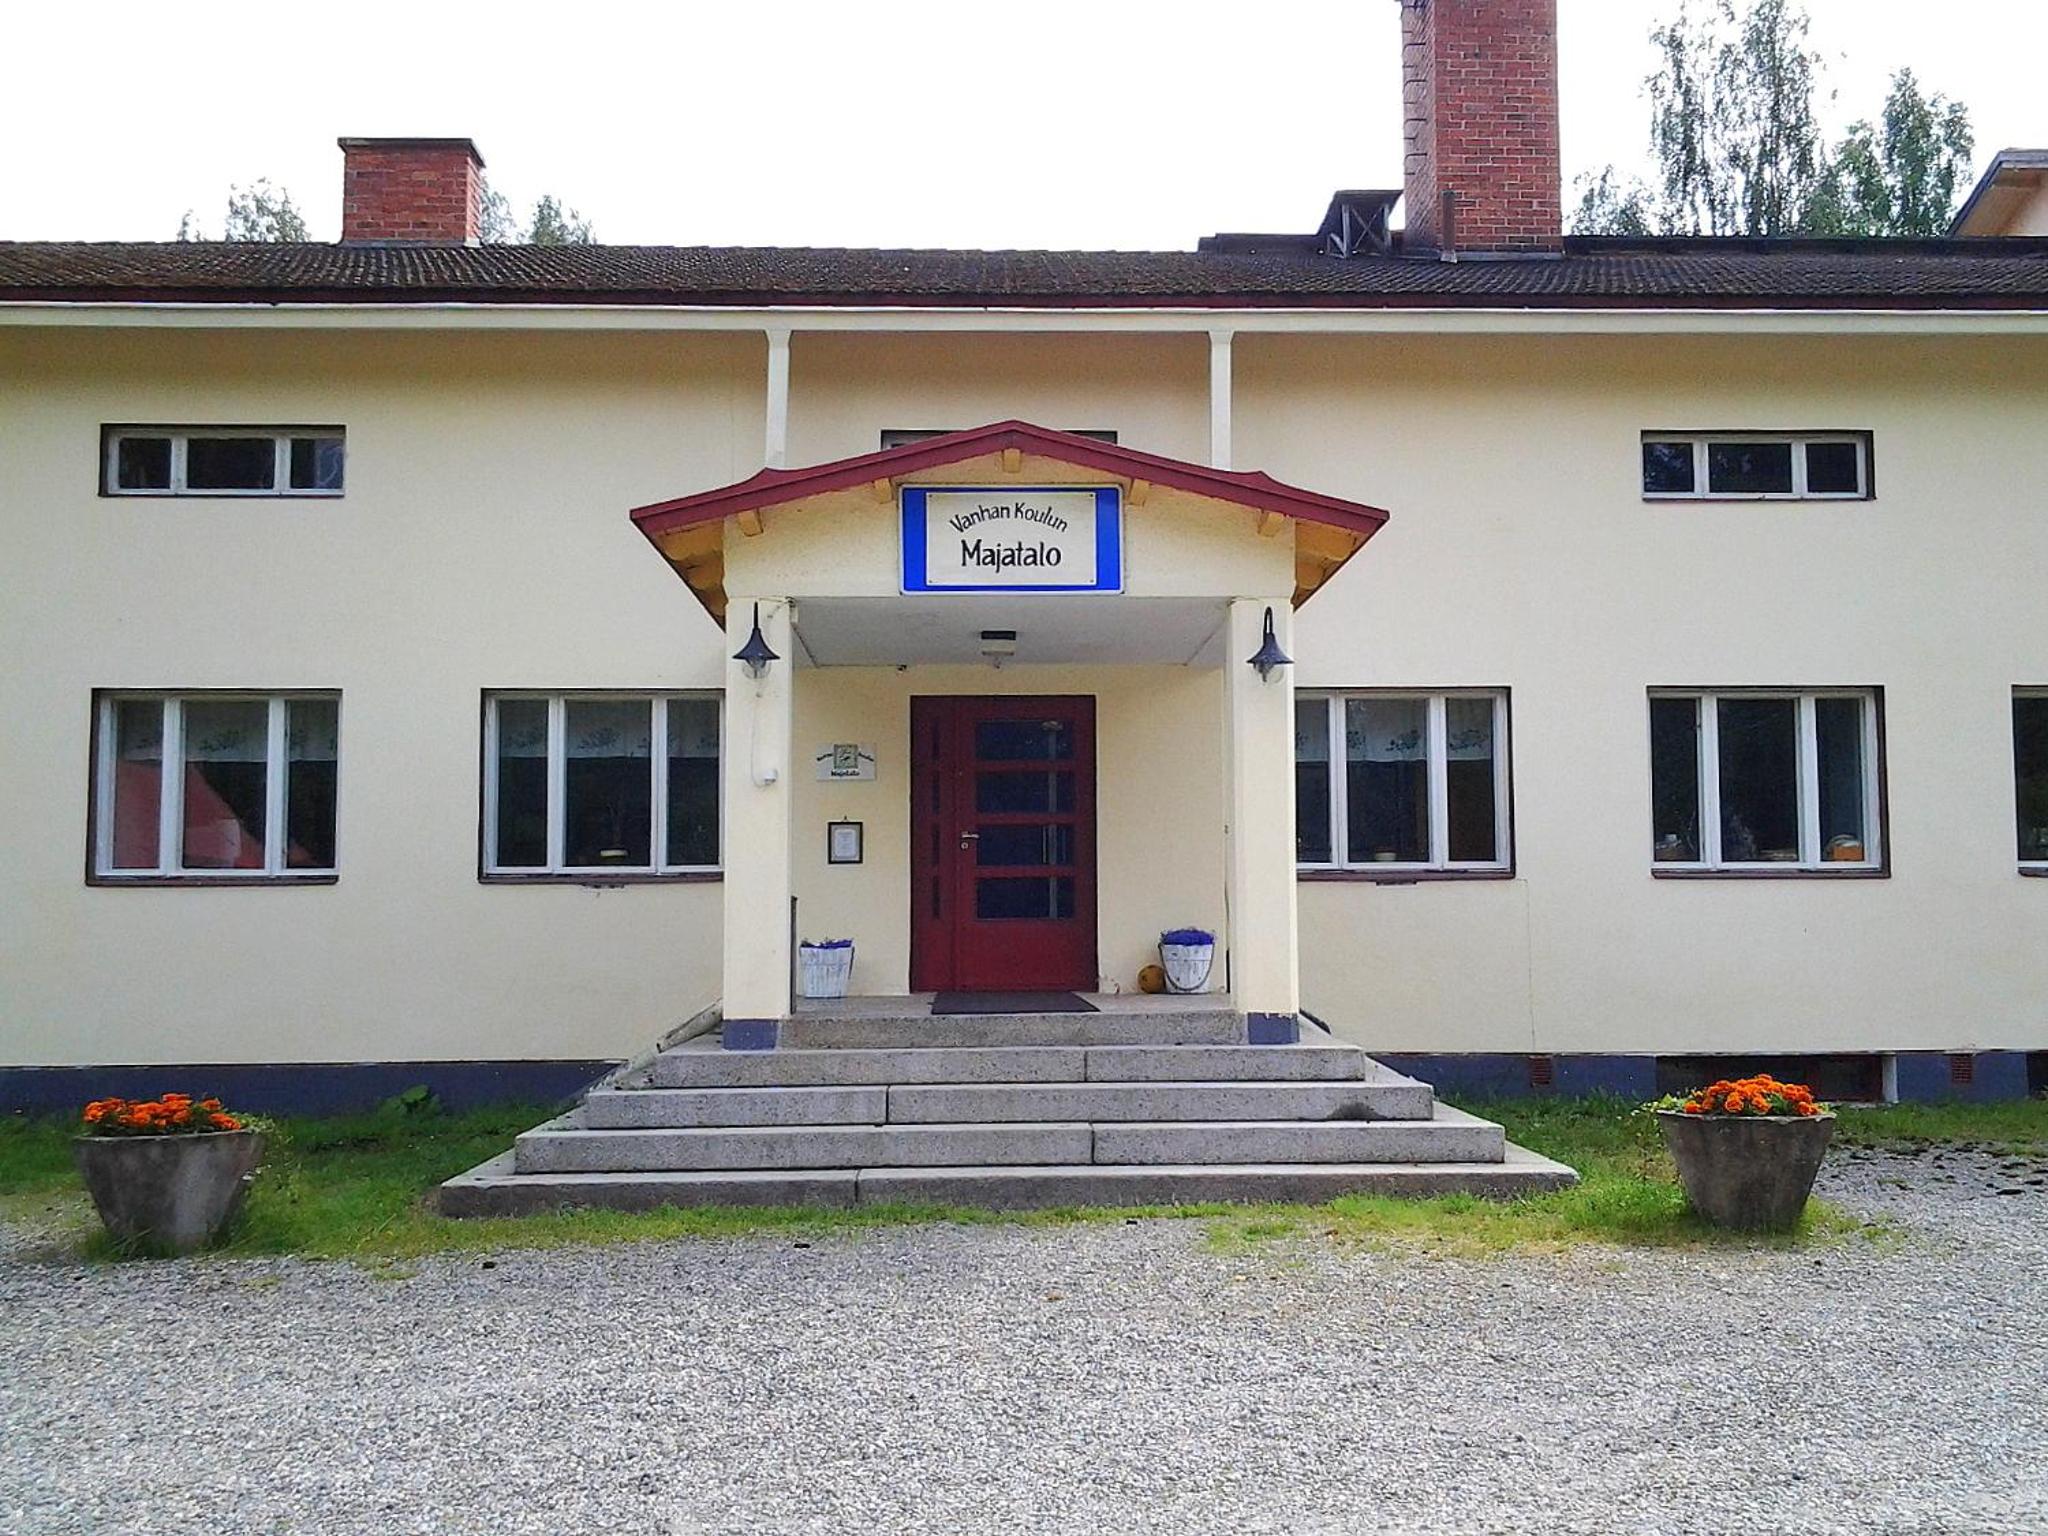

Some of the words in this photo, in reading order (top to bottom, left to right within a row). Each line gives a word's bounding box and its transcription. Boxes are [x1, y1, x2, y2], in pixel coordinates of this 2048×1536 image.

[950, 504, 1010, 532] Vanhan
[1015, 502, 1068, 532] Koulun
[961, 539, 1062, 573] Majatalo
